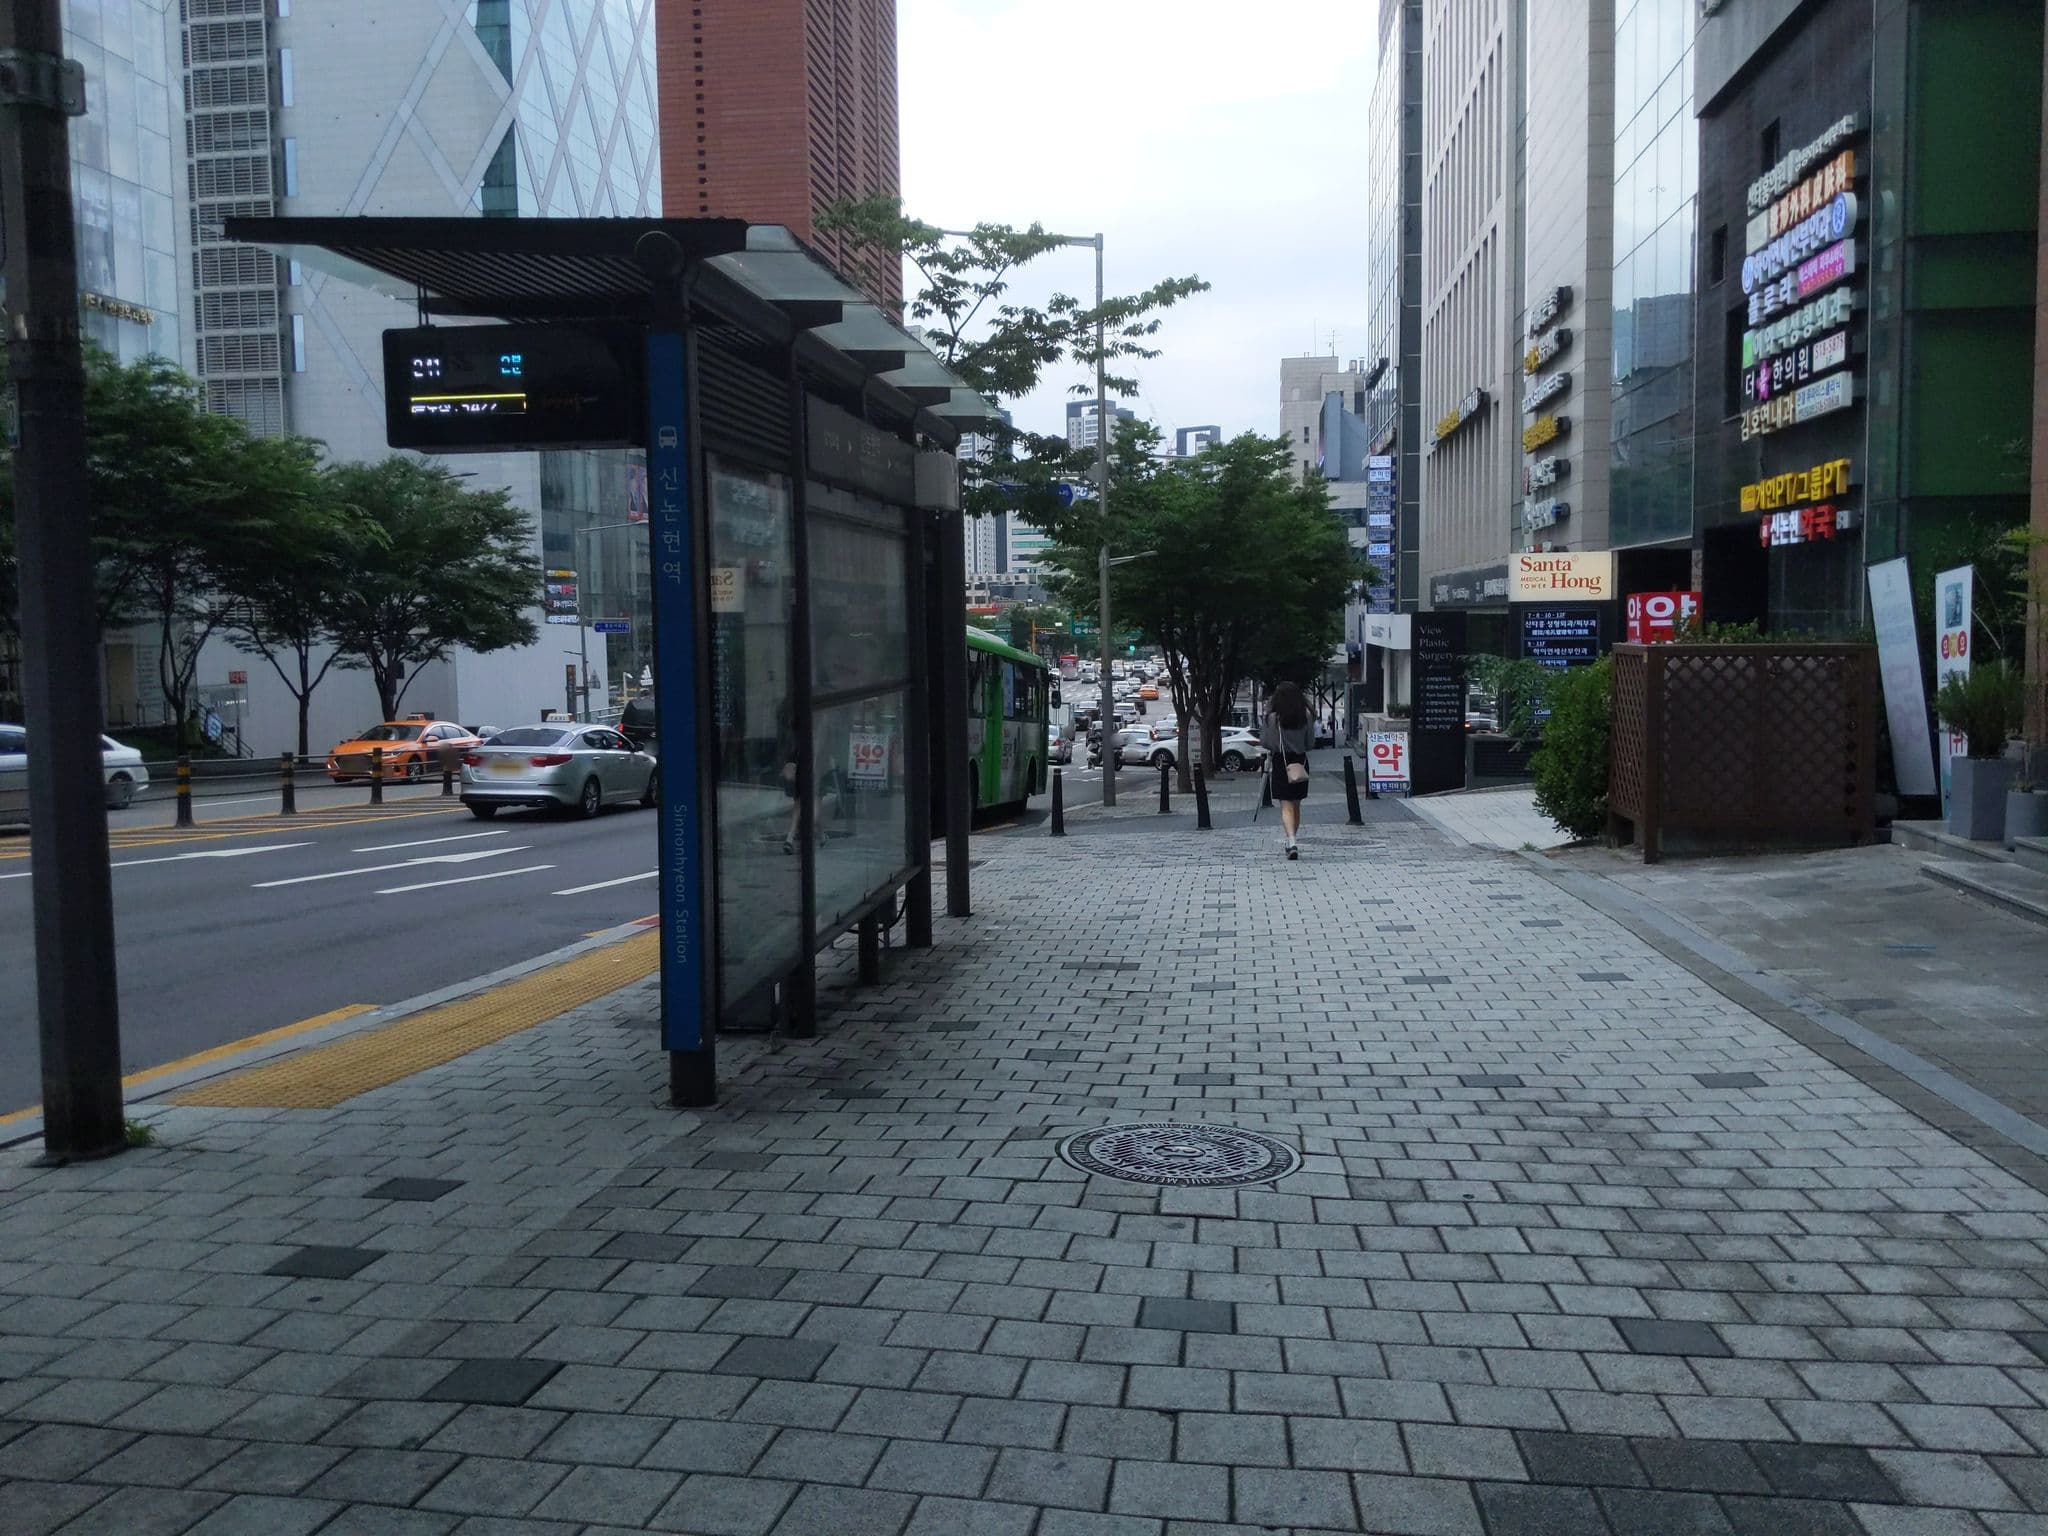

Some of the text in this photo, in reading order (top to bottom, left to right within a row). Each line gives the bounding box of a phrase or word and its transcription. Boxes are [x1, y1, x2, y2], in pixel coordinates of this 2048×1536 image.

[1749, 273, 1793, 325] 플로라
[1741, 395, 1794, 441] 김호연내과
[1756, 458, 1849, 509] 개인PT/그룹PT
[659, 467, 681, 585] 신논현역
[1770, 504, 1836, 546] 신논현약국
[1520, 556, 1571, 572] Santa
[1551, 573, 1602, 595] Hong
[1419, 625, 1442, 635] View
[1419, 637, 1449, 648] Plastic
[1419, 650, 1454, 662] Surgery
[1370, 733, 1405, 742] 신논현약국
[1373, 744, 1403, 771] 약
[673, 804, 689, 964] Sinnonhyeon Station
